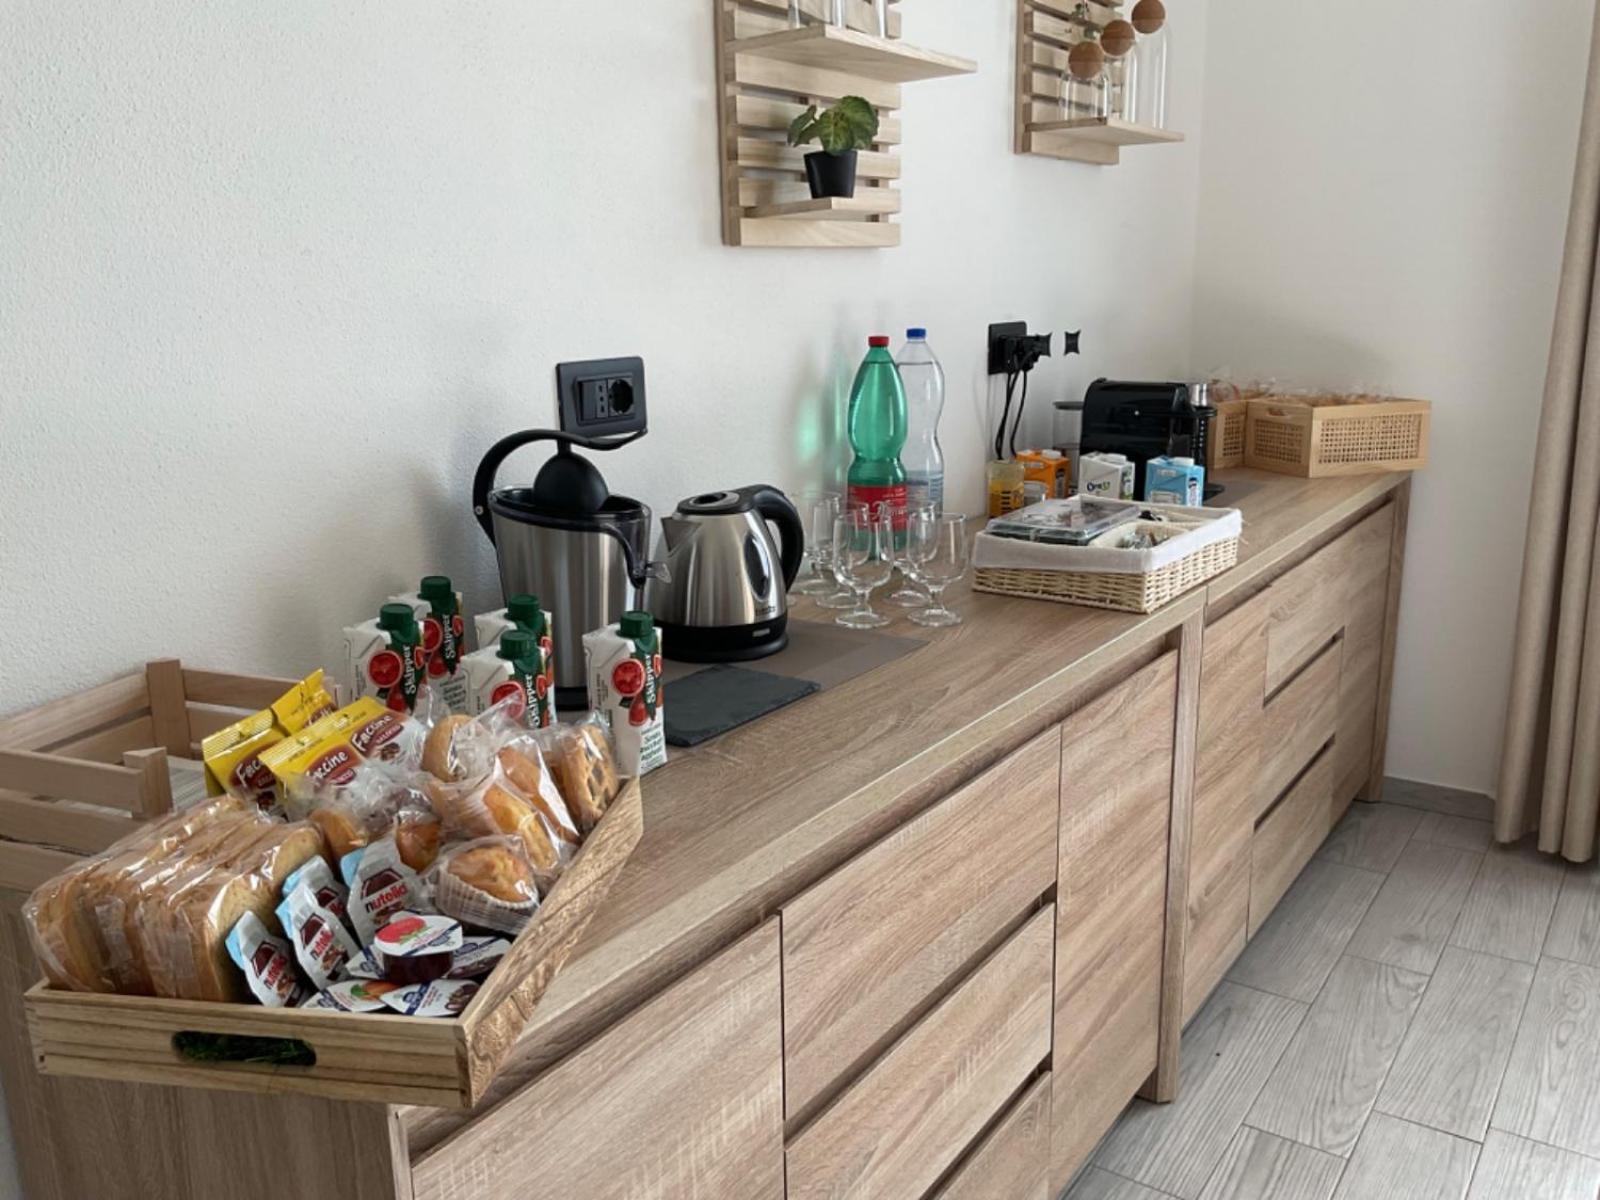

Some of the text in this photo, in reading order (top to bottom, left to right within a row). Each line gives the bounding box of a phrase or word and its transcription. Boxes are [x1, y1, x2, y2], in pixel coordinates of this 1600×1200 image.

[442, 614, 456, 659] Skipper
[402, 645, 416, 695] Skipper
[645, 654, 656, 704] Skipper
[365, 884, 408, 913] nutella
